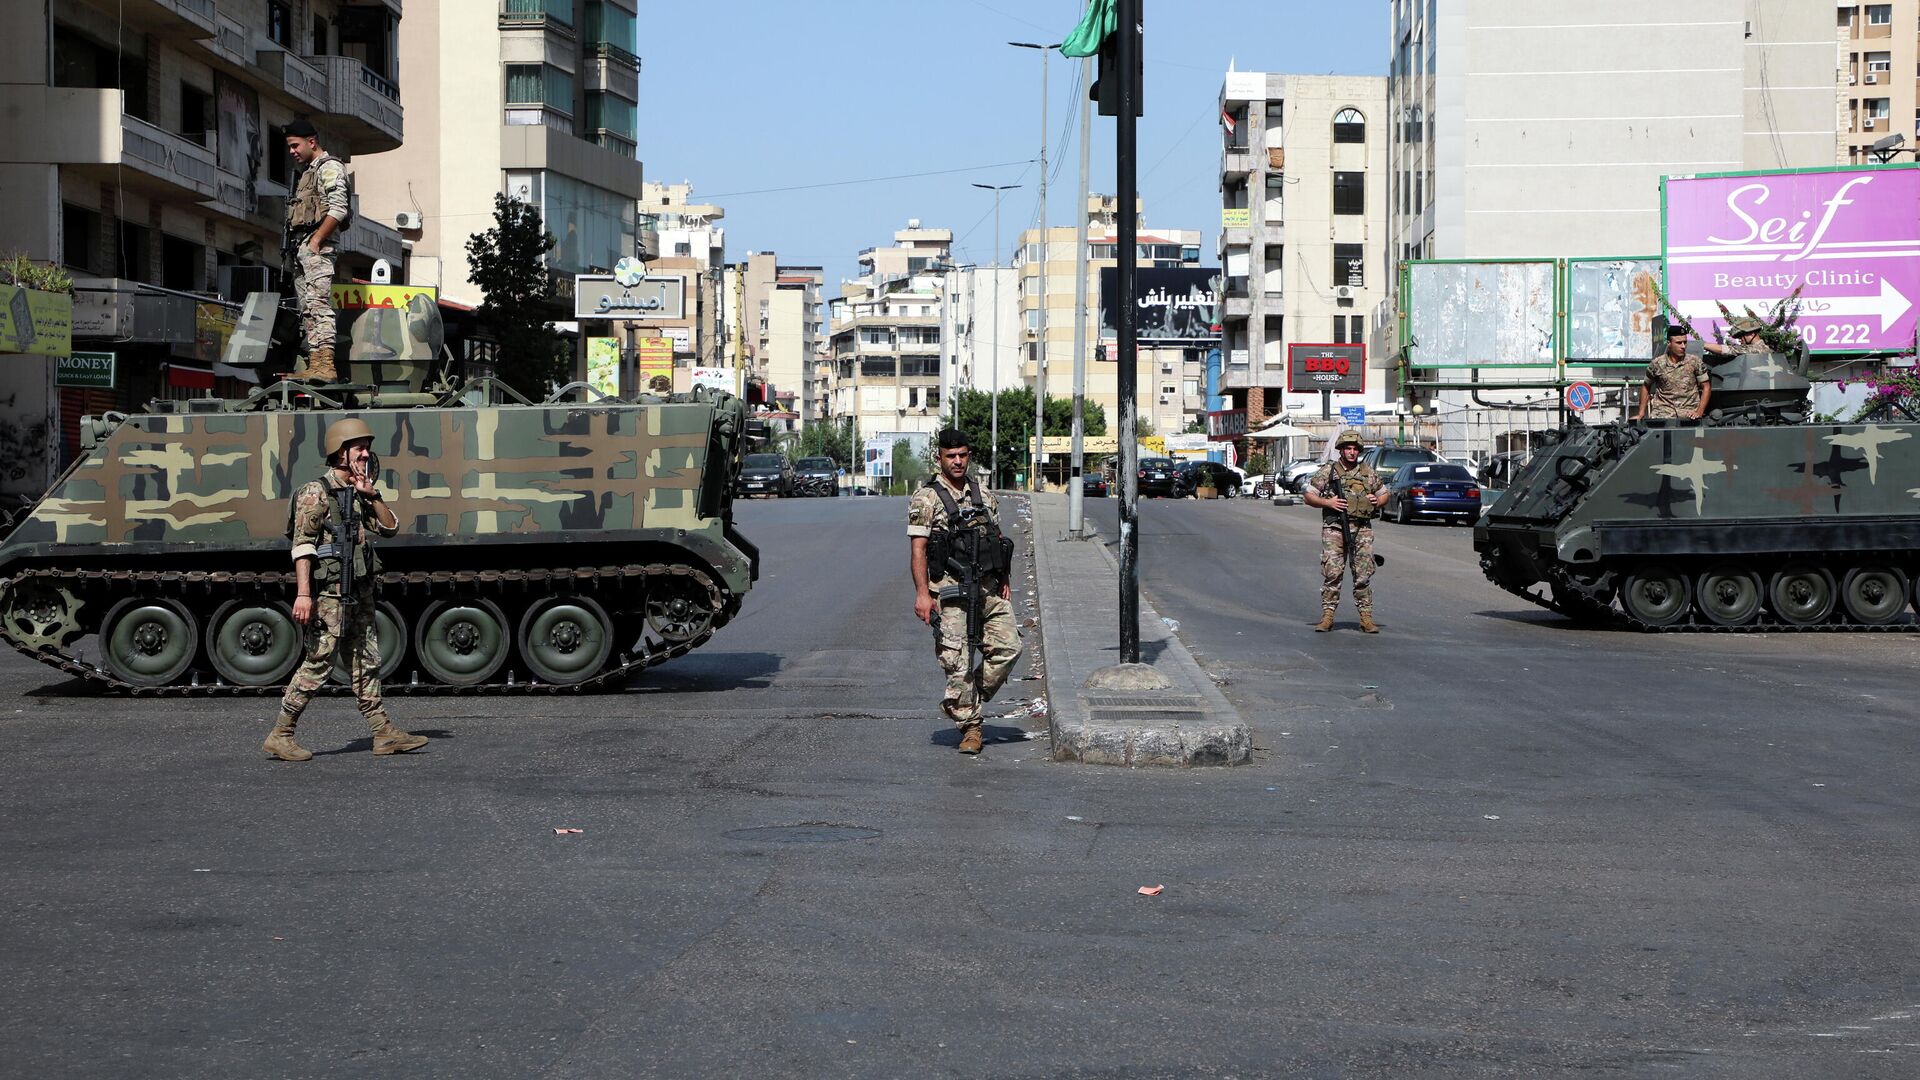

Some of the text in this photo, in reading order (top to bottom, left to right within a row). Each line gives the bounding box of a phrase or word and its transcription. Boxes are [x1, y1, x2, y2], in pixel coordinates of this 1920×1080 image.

[1707, 176, 1874, 262] Seif
[1713, 270, 1874, 290] Beauty Clinic
[1825, 326, 1870, 345] 222
[58, 357, 111, 370] MONEY
[1304, 358, 1349, 375] BBQ
